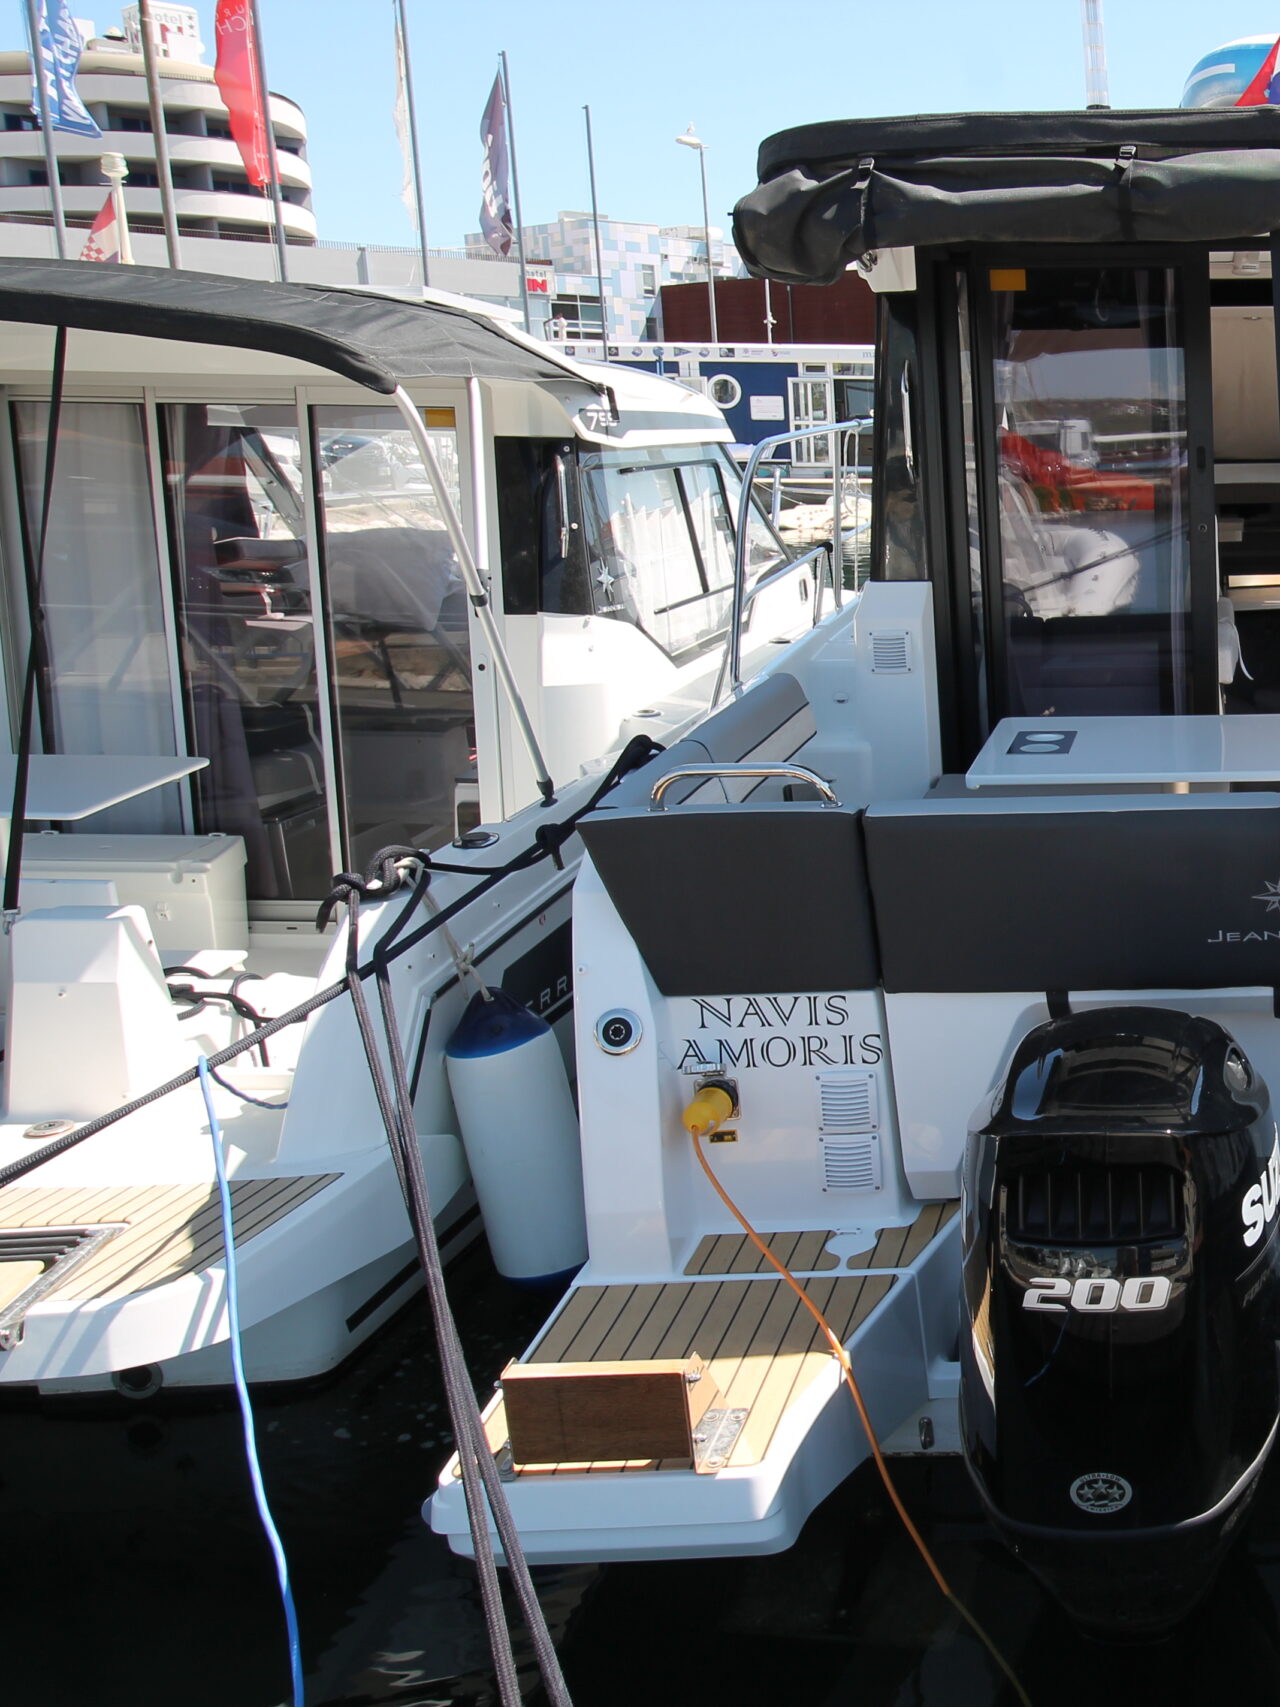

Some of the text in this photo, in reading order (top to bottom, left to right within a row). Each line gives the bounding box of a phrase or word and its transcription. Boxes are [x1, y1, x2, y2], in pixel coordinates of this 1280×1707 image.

[527, 278, 548, 293] IN
[691, 995, 849, 1029] NAVIS
[677, 1034, 883, 1070] AMORIS
[1022, 1276, 1173, 1312] 200
